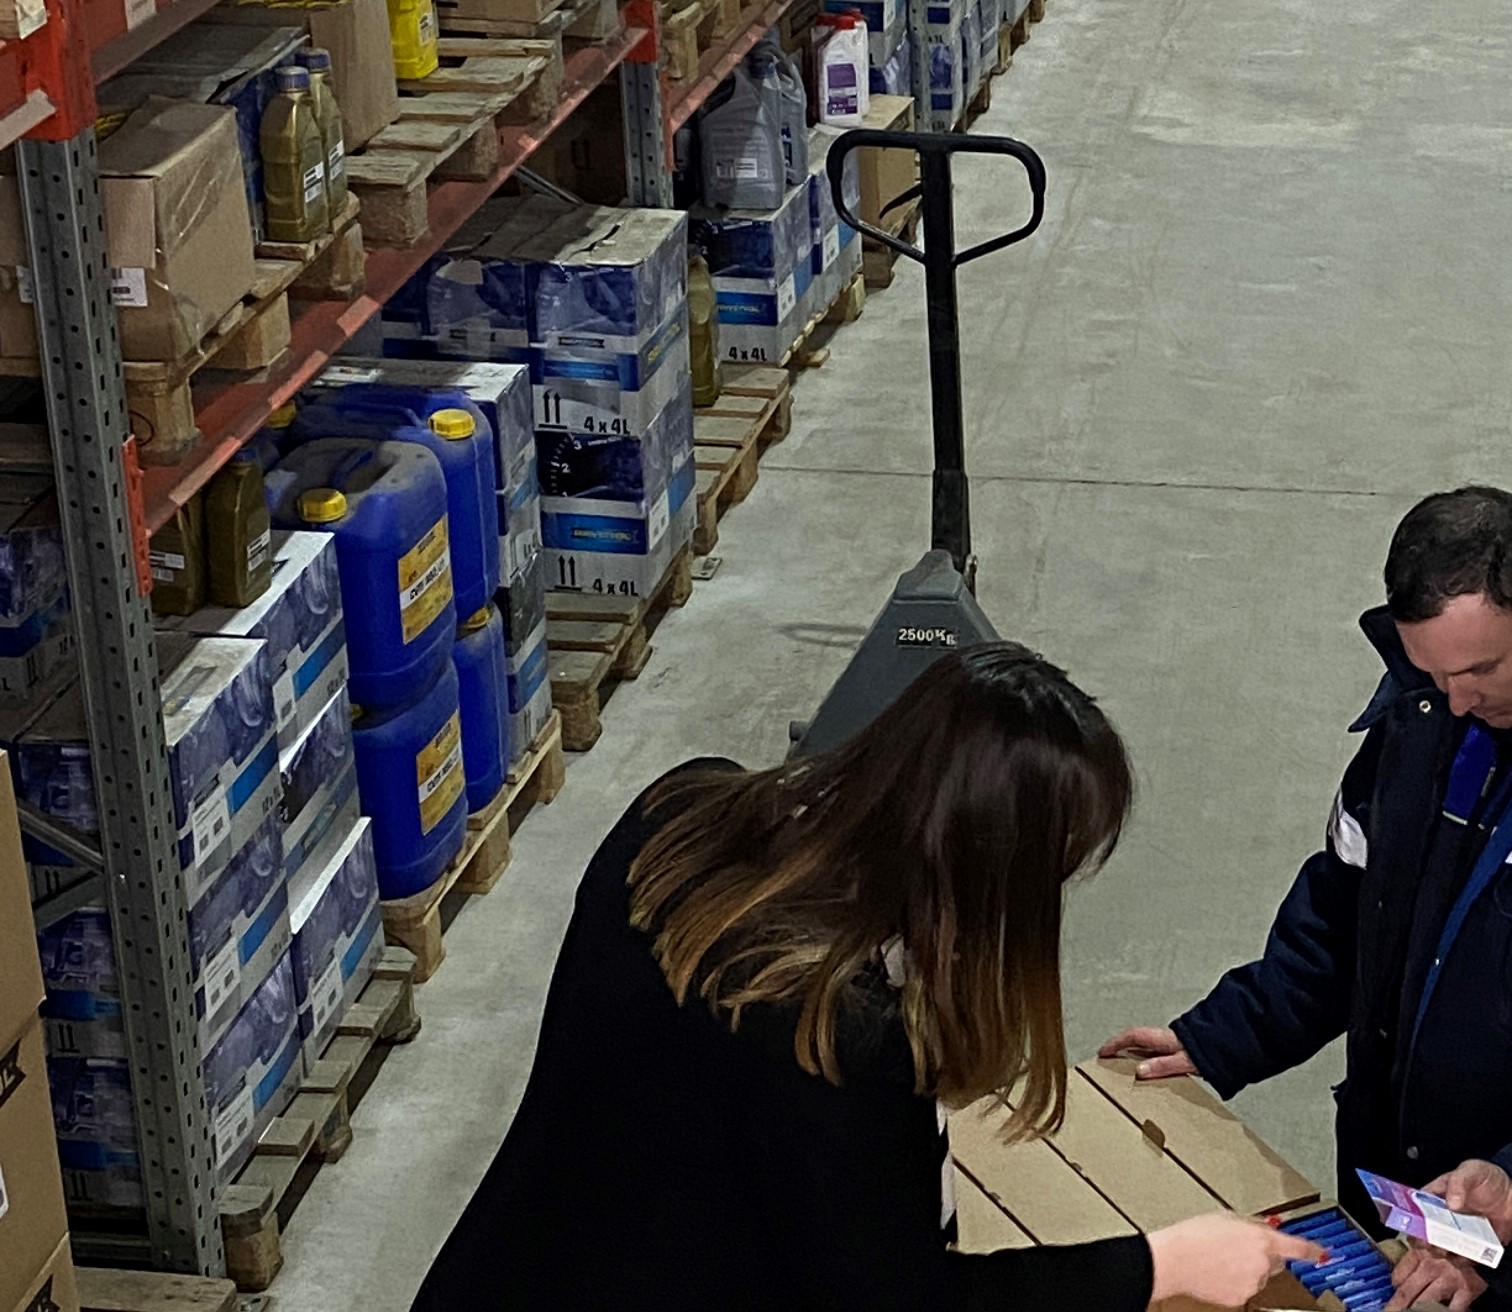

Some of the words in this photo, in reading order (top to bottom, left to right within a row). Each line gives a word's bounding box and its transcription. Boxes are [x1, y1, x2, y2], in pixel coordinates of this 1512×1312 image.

[584, 416, 595, 432] 4
[611, 418, 631, 435] 4L
[593, 579, 604, 593] 4
[619, 580, 640, 597] 4L
